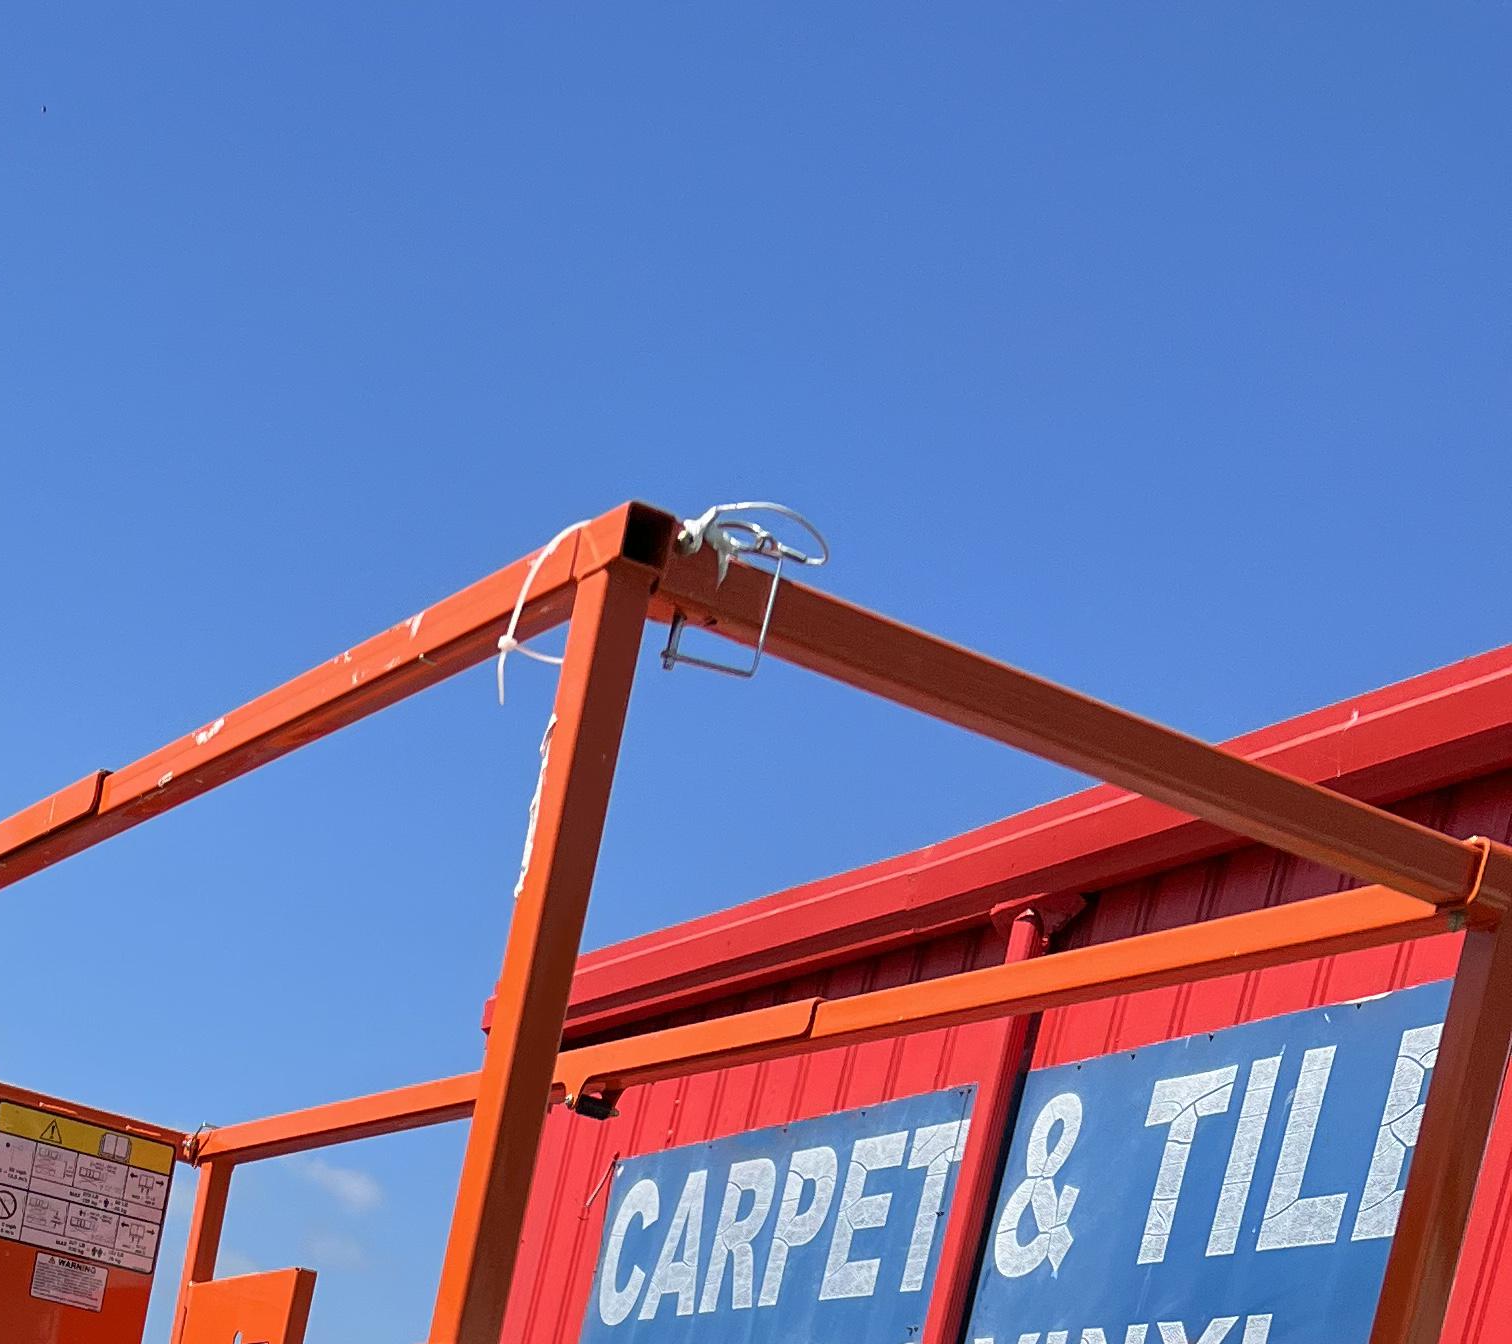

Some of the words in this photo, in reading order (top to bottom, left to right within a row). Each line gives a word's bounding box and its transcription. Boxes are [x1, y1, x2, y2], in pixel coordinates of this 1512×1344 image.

[58, 1258, 97, 1275] WARNING
[599, 1118, 970, 1326] CARPET
[994, 1092, 1080, 1279] &
